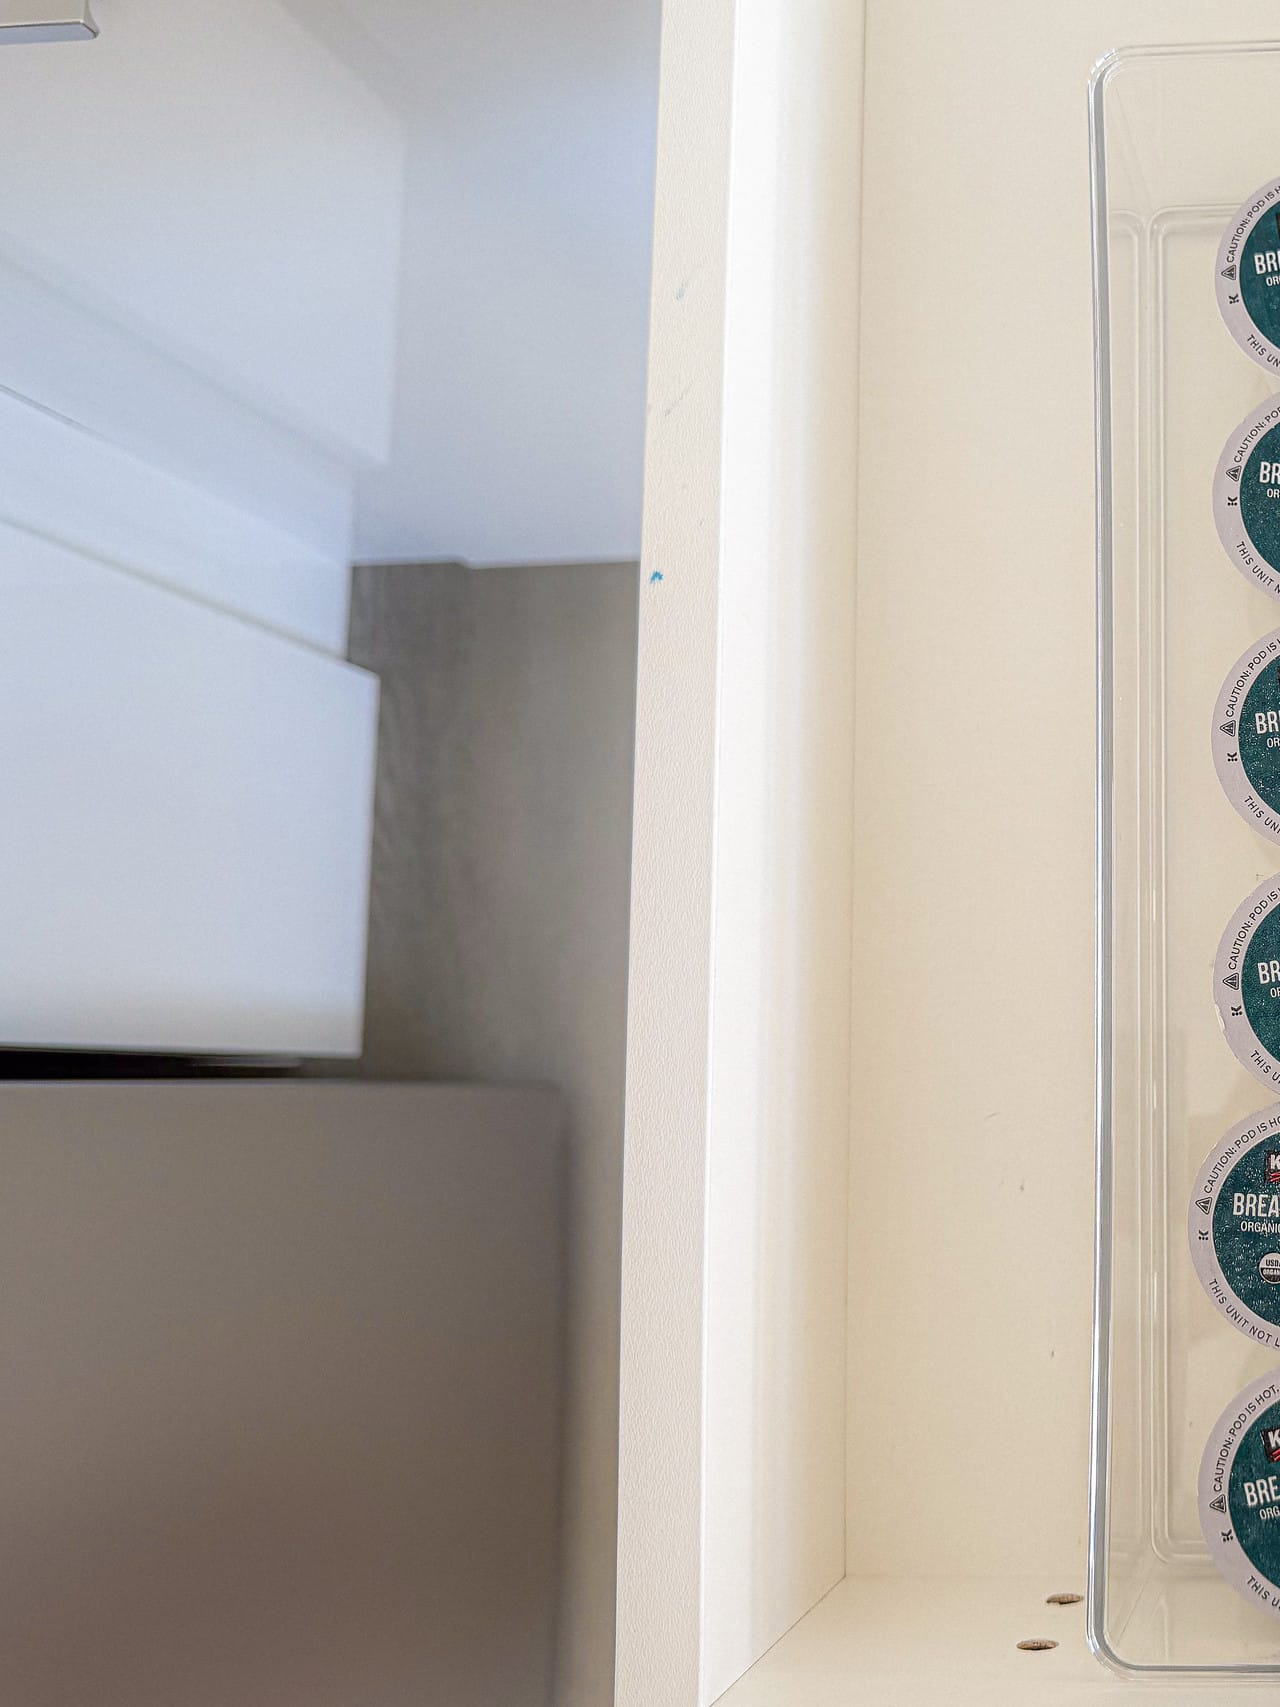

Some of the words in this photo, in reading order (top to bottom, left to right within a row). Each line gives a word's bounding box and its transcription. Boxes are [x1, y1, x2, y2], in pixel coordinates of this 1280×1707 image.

[1225, 215, 1250, 260] CAUTION:
[1246, 197, 1265, 216] POD
[1264, 189, 1275, 199] IS
[1244, 332, 1266, 354] THIS
[1245, 1576, 1270, 1600] THIS
